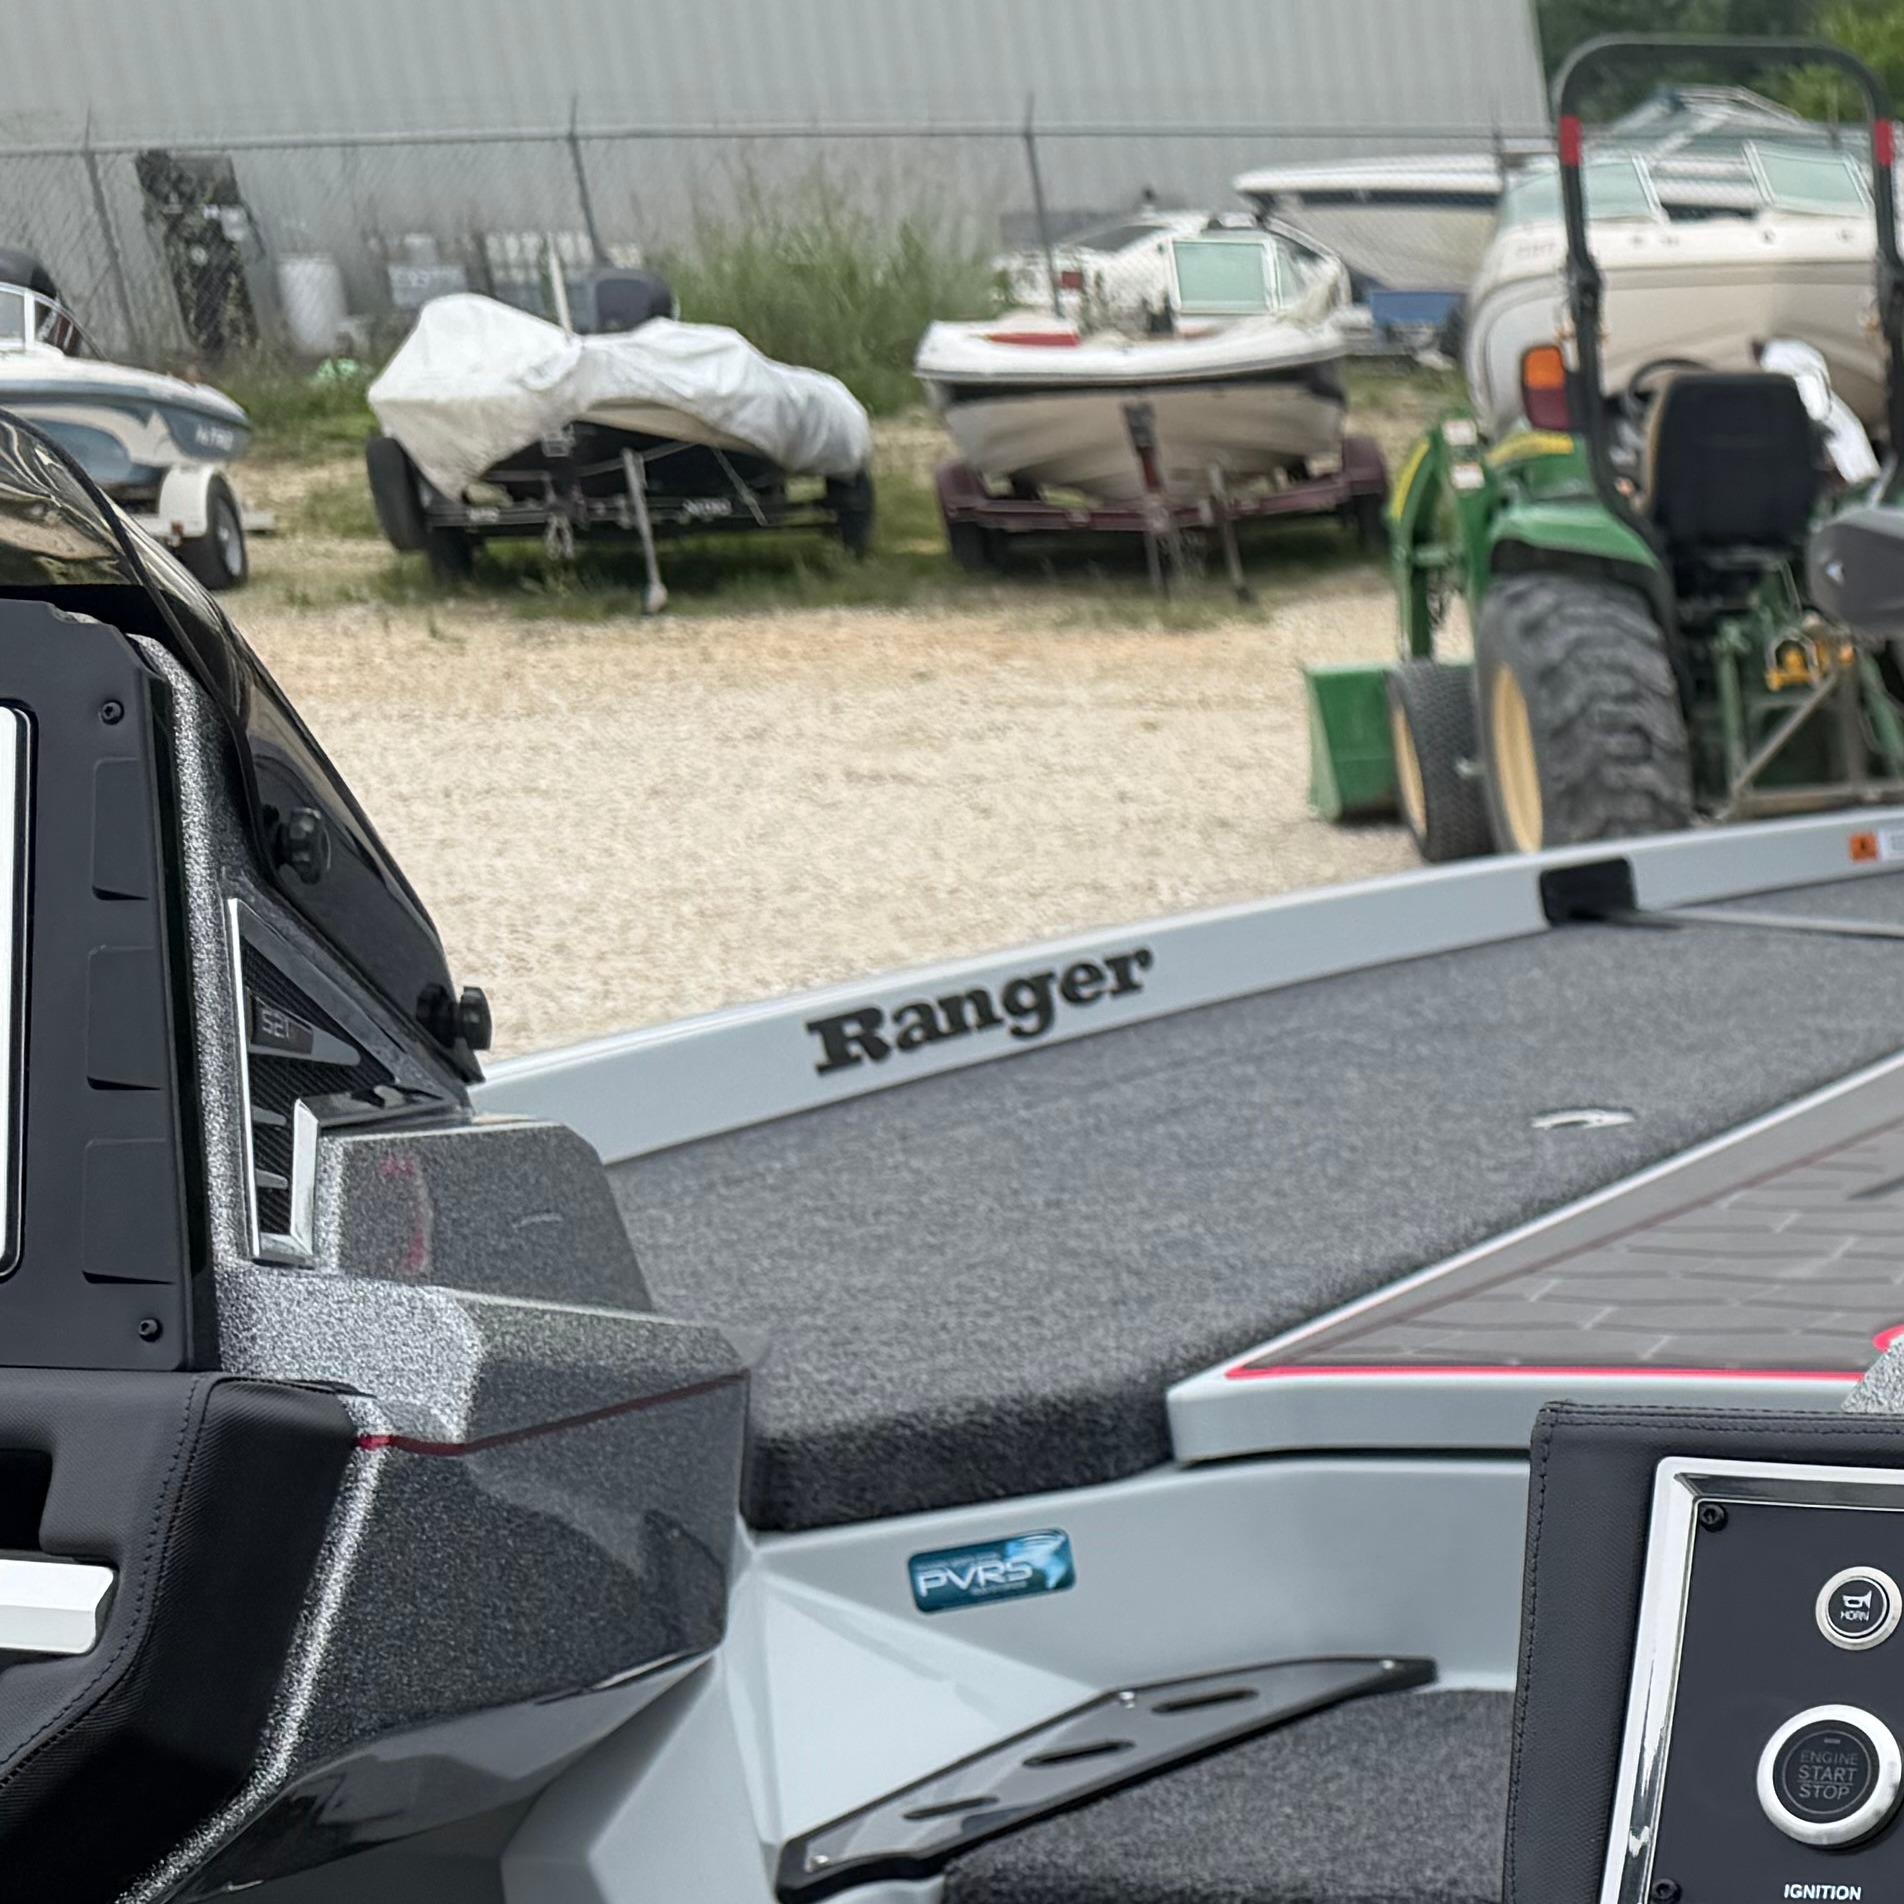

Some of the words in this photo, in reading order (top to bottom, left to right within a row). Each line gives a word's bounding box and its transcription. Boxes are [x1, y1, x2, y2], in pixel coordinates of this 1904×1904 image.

[805, 948, 1154, 1075] Ranger
[917, 1559, 1033, 1598] PVRS
[1840, 1610, 1871, 1621] HORN
[1800, 1750, 1859, 1767] ENGINE
[1799, 1764, 1859, 1783] START
[1798, 1782, 1851, 1801] STOP
[1783, 1884, 1863, 1901] IGNITION
